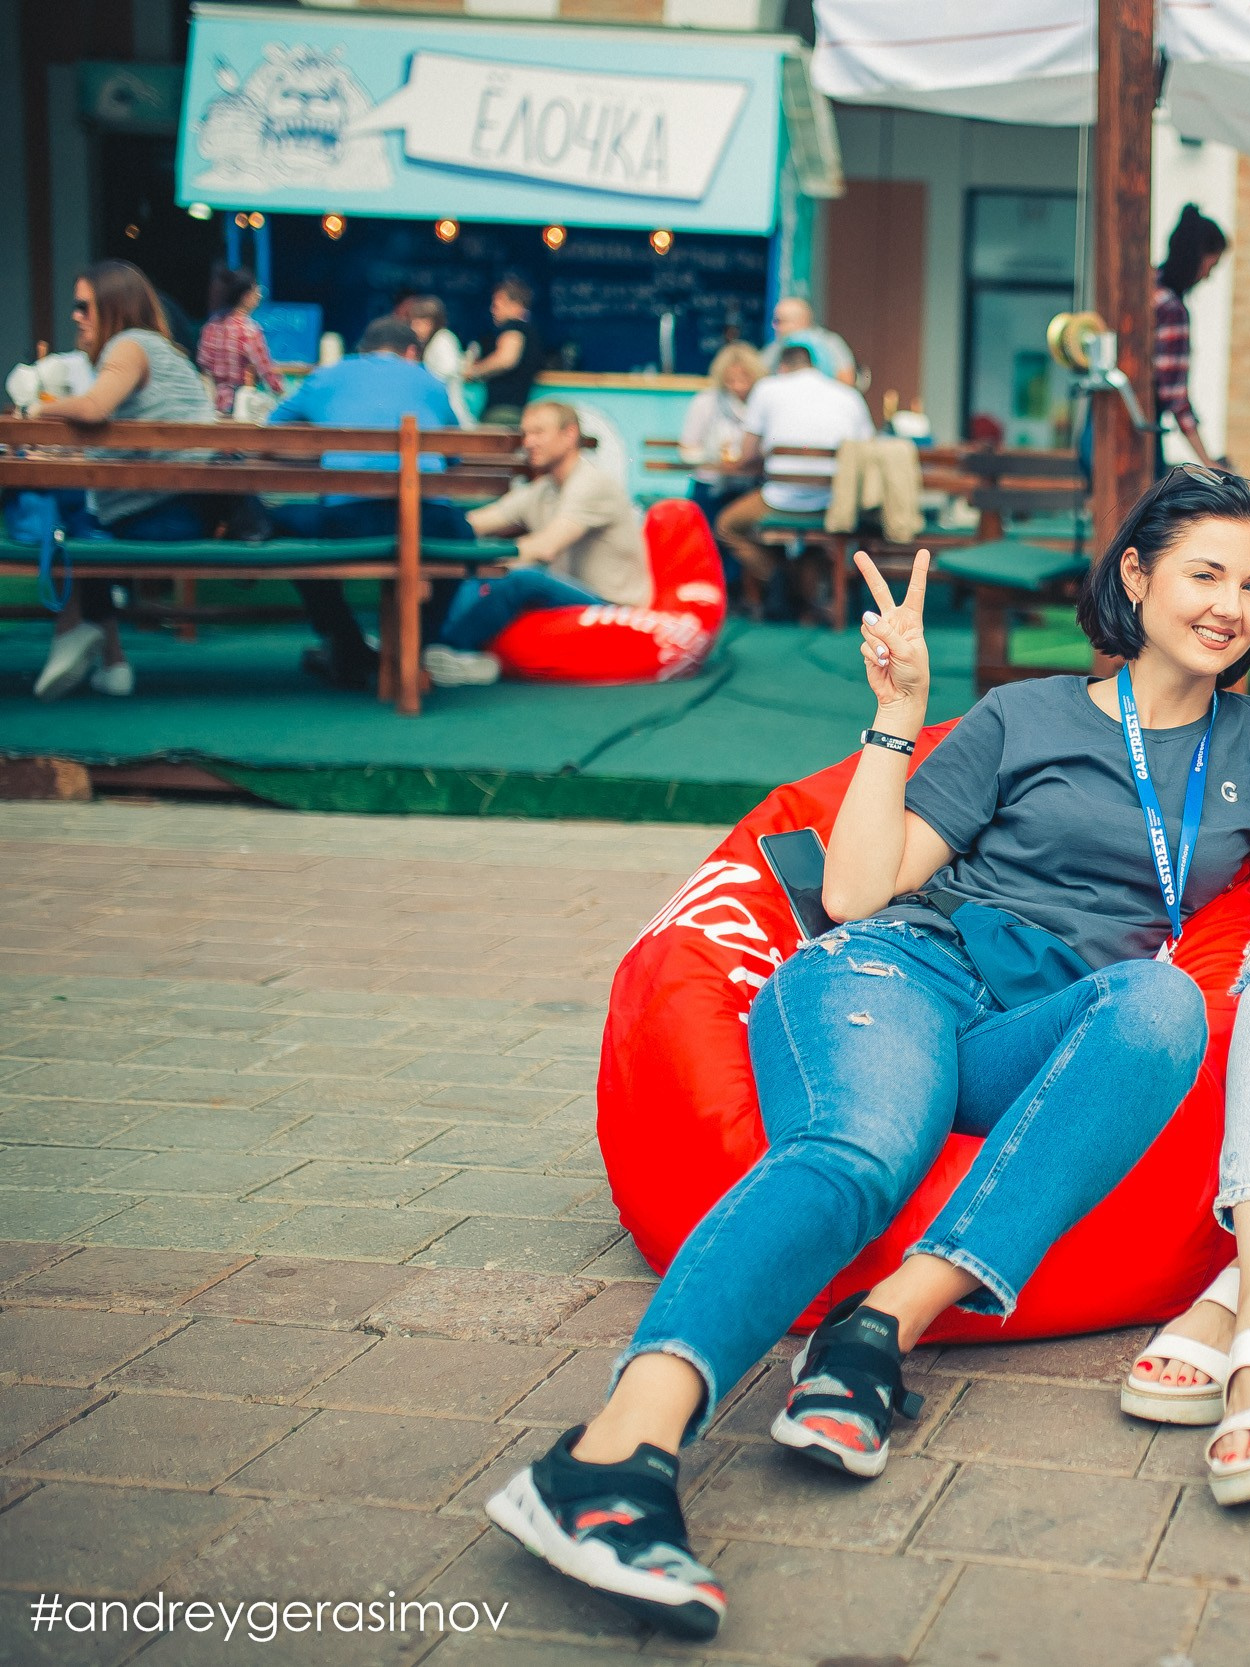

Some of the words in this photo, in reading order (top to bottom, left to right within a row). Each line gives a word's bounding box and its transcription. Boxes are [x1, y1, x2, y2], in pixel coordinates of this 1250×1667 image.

[470, 72, 669, 184] ЁЛОЧКА
[1126, 713, 1148, 780] GASTREET
[1221, 781, 1238, 803] G
[1151, 828, 1175, 906] GASTREET
[861, 1318, 889, 1337] REPLAY
